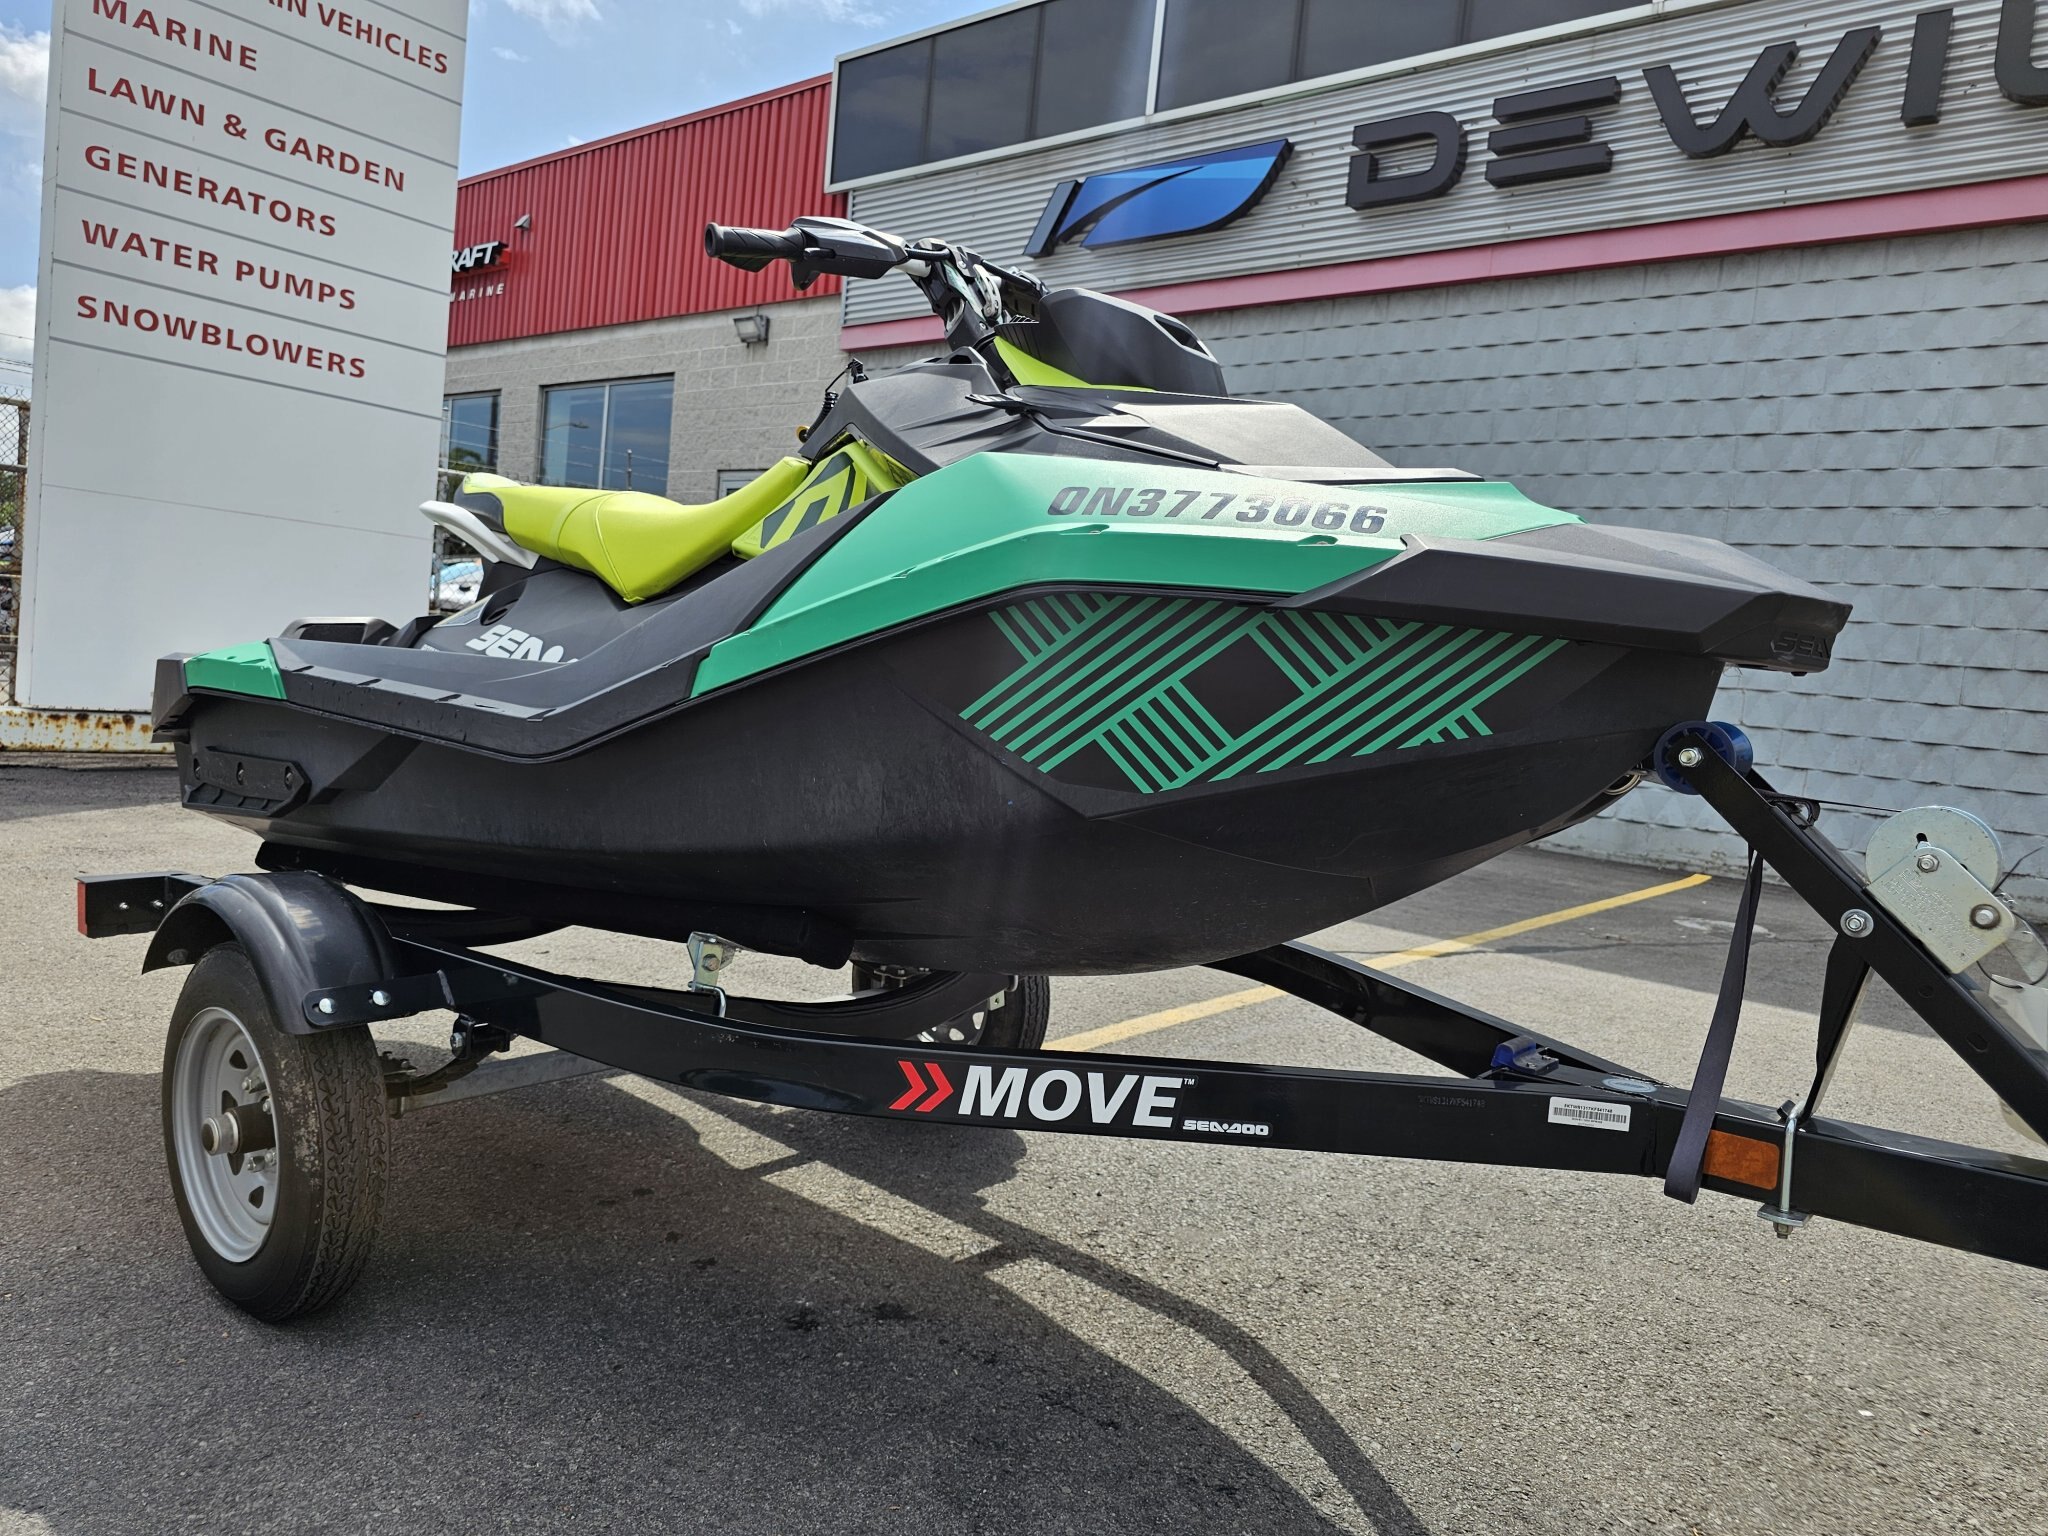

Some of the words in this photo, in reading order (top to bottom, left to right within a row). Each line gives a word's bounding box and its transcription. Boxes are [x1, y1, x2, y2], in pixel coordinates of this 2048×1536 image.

[92, 0, 257, 72] MARINE
[317, 2, 448, 75] VEHICLES
[88, 67, 205, 127] LAWN
[224, 113, 247, 139] &
[264, 128, 405, 192] GARDEN
[84, 145, 337, 238] GENERATORS
[82, 220, 219, 275] WATER
[236, 261, 356, 311] PUMPS
[77, 295, 365, 380] SNOWBLOWERS
[1047, 486, 1389, 534] ON3773066
[957, 1064, 1183, 1129] MOVE
